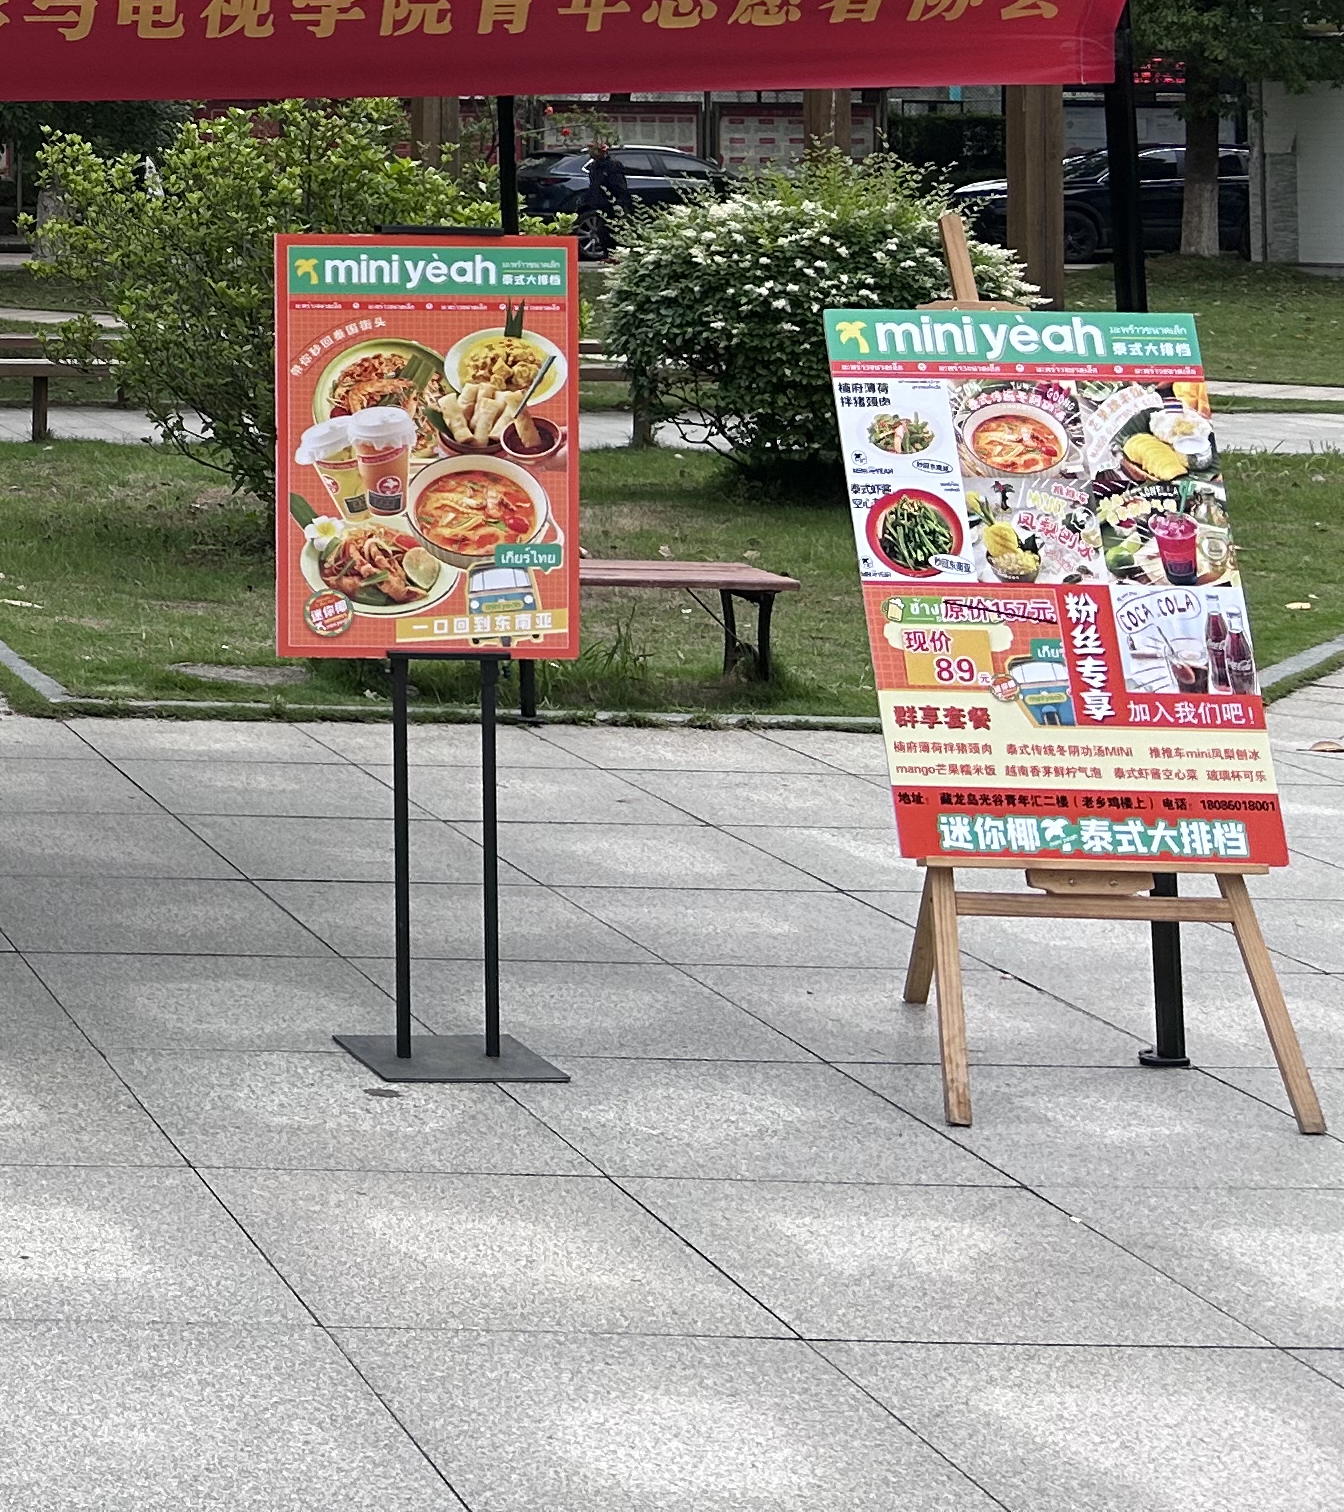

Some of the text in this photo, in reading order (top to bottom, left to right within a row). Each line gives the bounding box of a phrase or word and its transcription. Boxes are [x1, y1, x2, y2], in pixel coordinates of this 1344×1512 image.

[502, 274, 561, 286] 泰式大排档
[1112, 341, 1192, 357] 泰式大排档
[852, 498, 880, 509] 空心
[412, 613, 552, 635] 一口回到东南亚
[903, 630, 952, 653] 现价
[1064, 592, 1116, 721] 粉丝专享
[893, 704, 992, 731] 群享套餐
[938, 815, 1041, 852] 迷你椰
[1078, 818, 1249, 857] 泰式大排档
